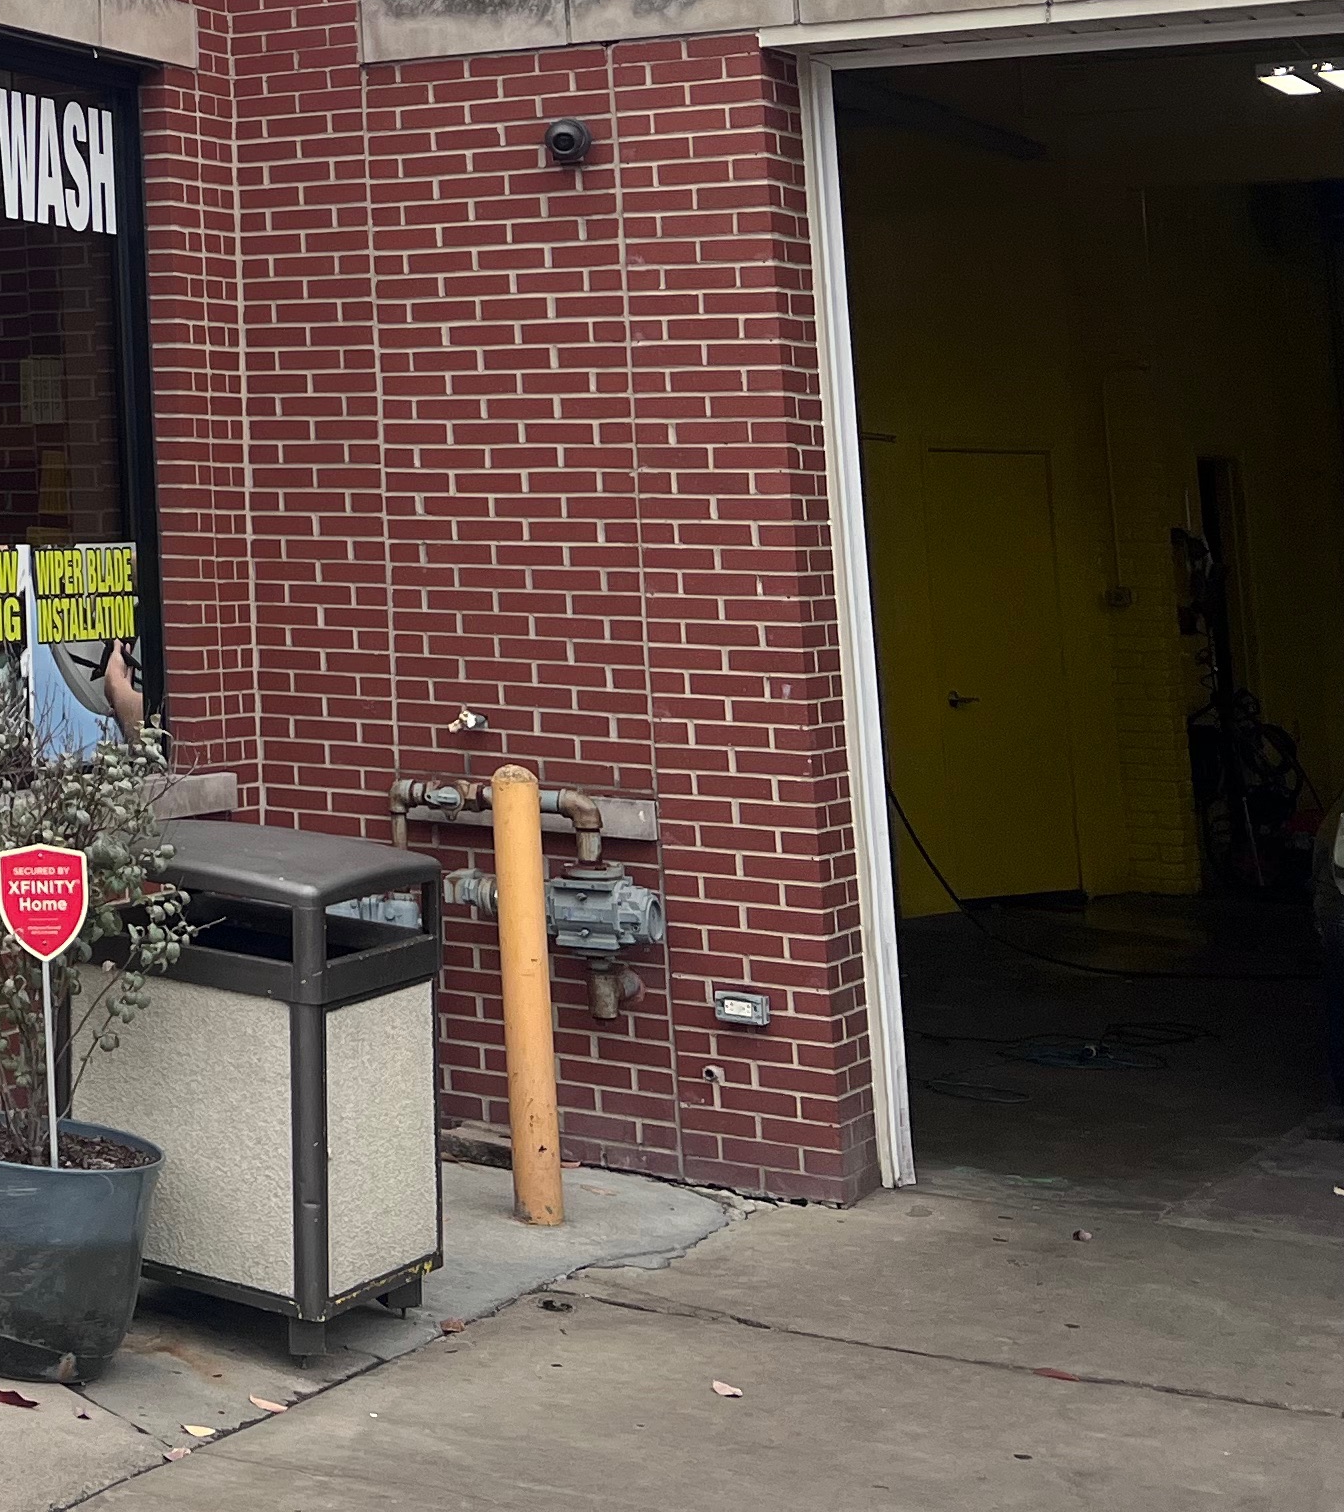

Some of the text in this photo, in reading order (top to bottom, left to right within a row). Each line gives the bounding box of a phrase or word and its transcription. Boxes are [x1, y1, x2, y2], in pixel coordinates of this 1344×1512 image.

[36, 548, 133, 596] WIPER BLADE
[37, 596, 135, 644] INSTALLATION
[13, 866, 70, 876] SECURED BY
[8, 880, 76, 895] XFINITY
[19, 898, 68, 912] Home
